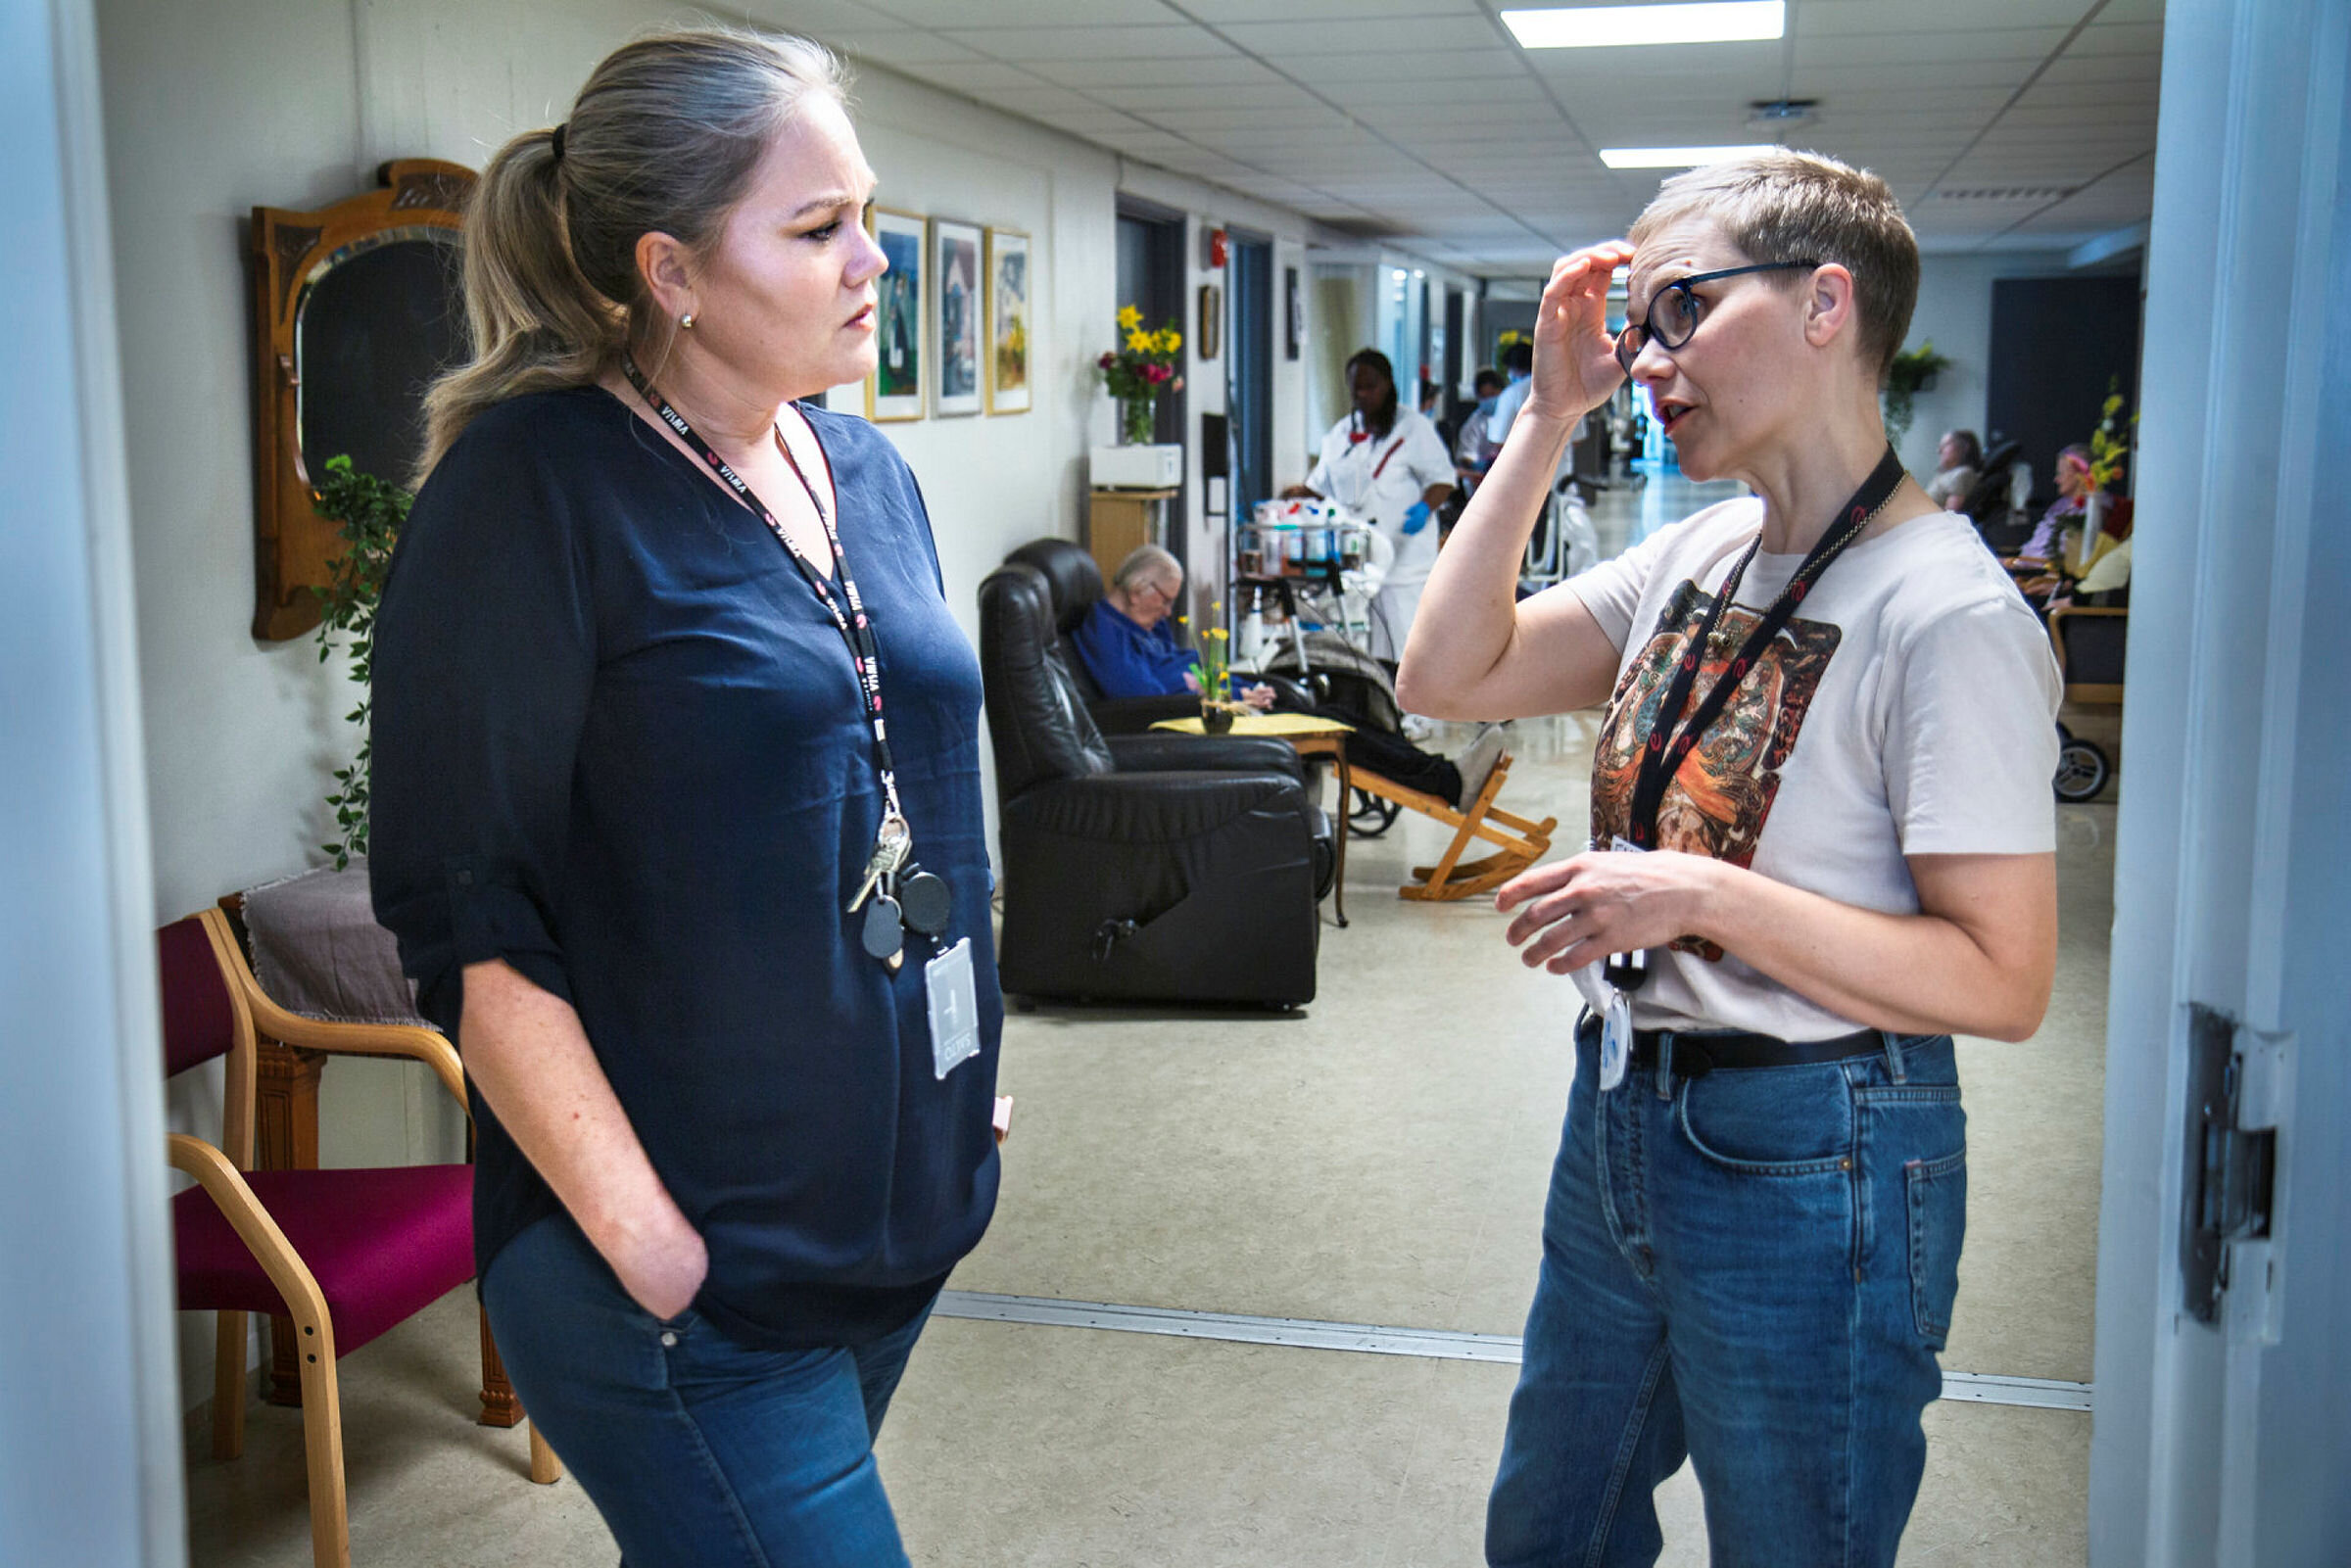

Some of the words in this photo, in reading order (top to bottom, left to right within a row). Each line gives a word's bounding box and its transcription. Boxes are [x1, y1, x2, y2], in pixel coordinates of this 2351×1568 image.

[661, 406, 689, 435] VISMA
[720, 465, 747, 494] VISMA
[777, 528, 802, 557] VISMA
[827, 597, 847, 630] VISMA
[864, 656, 880, 691] VISMA
